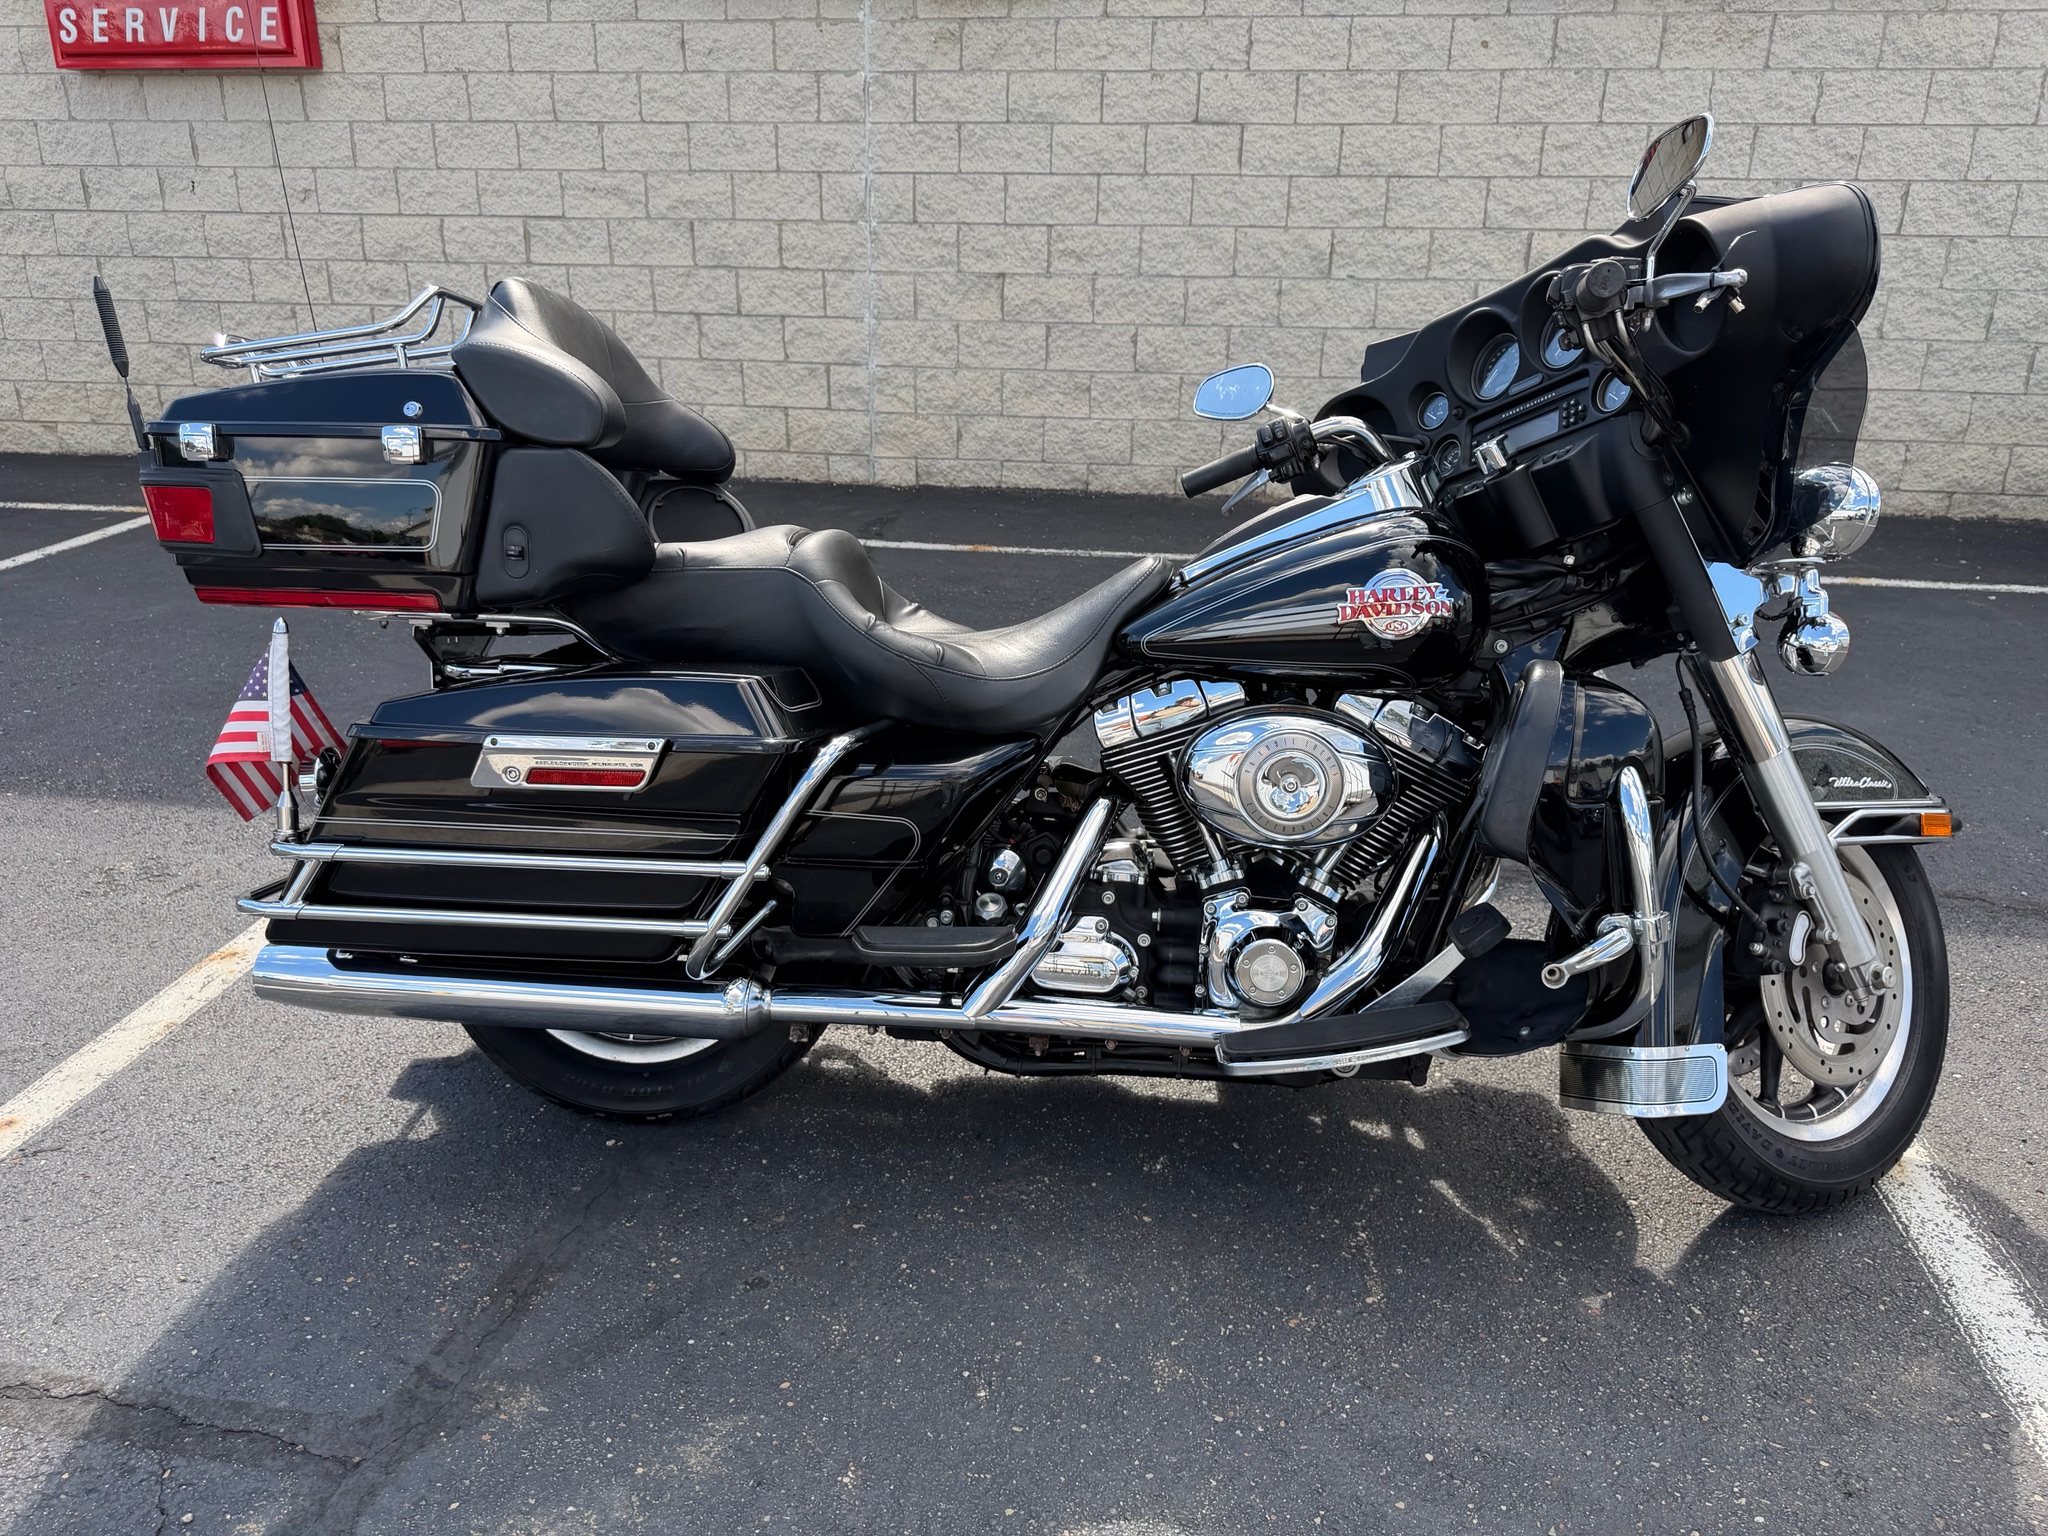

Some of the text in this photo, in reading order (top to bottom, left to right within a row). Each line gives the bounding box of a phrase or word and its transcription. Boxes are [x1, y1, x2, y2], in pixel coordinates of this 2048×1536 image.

[59, 7, 279, 43] SERVICE
[1338, 601, 1452, 621] DAVIDSON
[1828, 776, 1892, 788] Ultra Classic
[1726, 1100, 1773, 1152] DAVID
